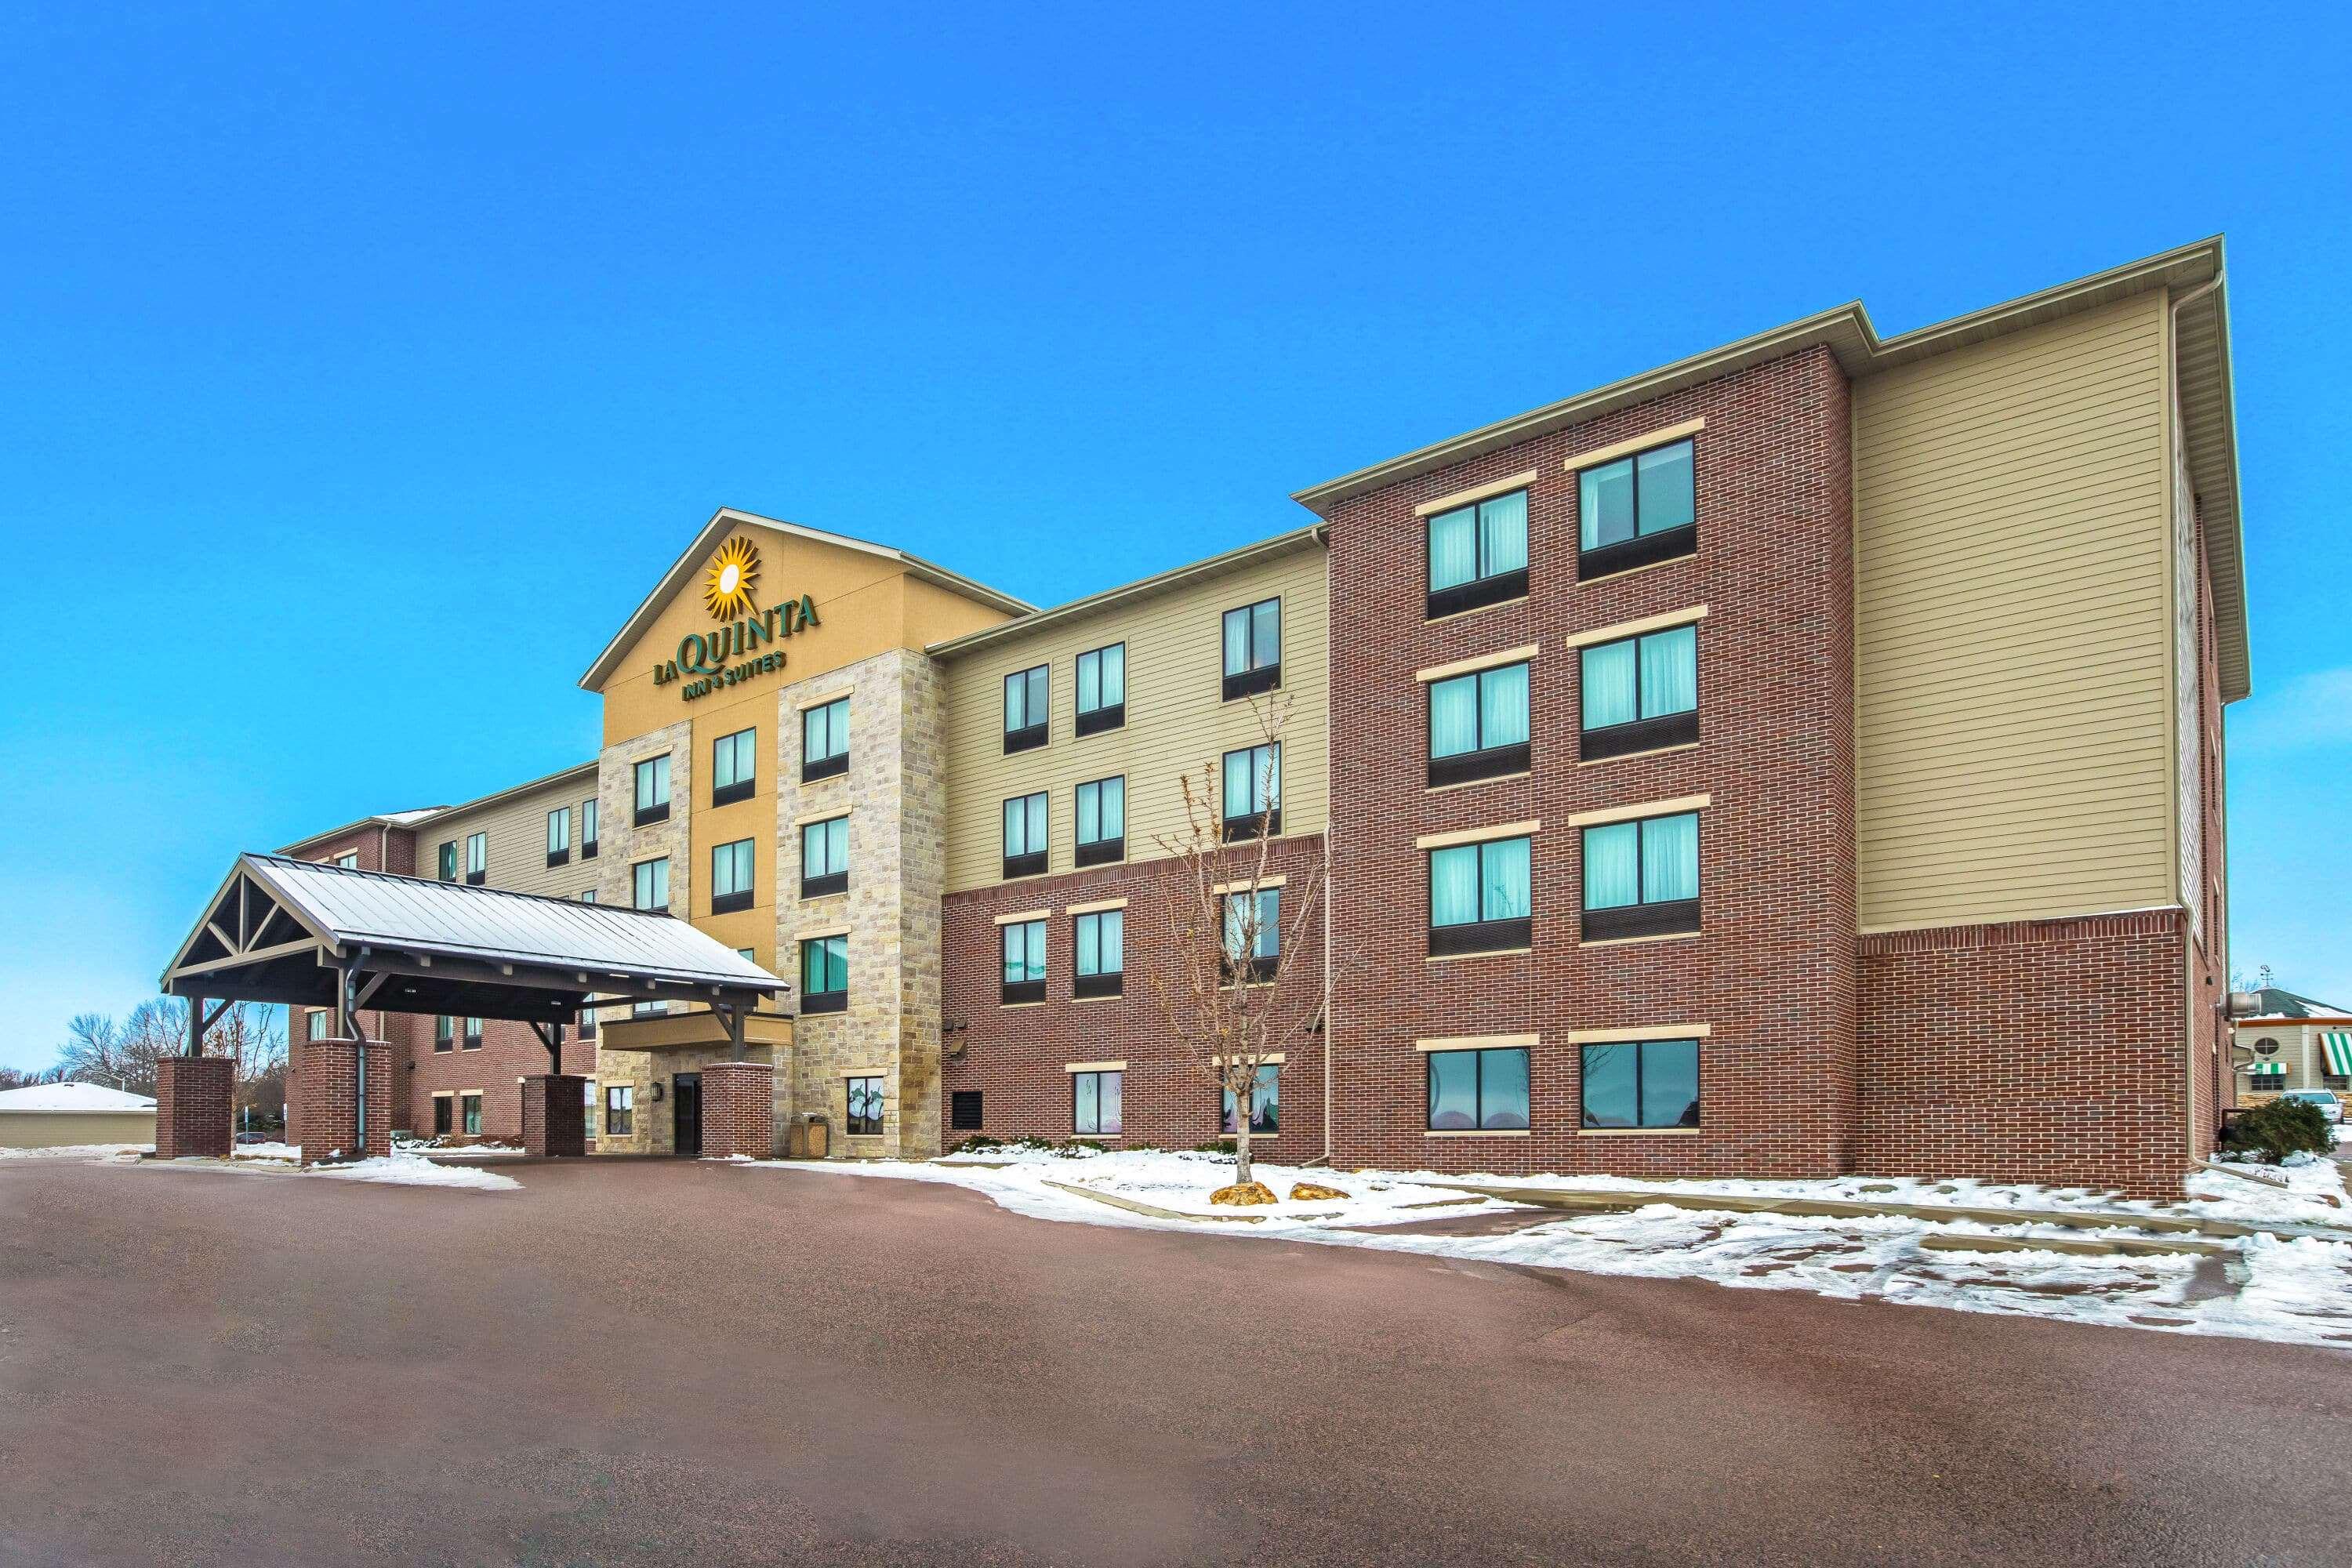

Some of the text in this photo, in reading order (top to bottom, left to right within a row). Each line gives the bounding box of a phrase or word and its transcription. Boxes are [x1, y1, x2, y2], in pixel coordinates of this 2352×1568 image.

[653, 593, 821, 685] LA QUINTA
[682, 650, 786, 701] INN & SUITES
